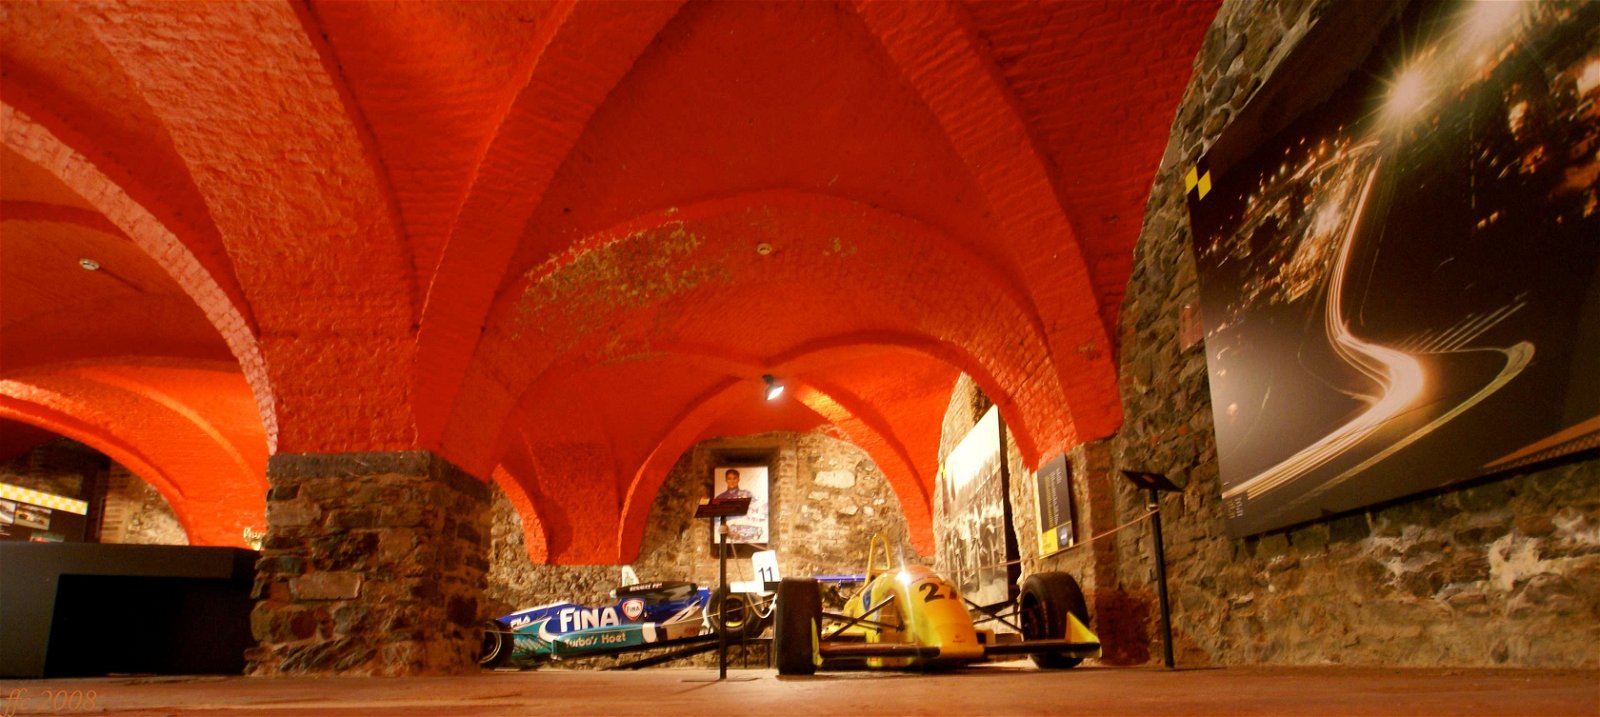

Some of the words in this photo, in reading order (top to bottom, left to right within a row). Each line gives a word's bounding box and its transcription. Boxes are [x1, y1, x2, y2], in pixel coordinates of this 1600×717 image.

[758, 566, 773, 582] 11
[626, 602, 640, 613] FINA
[559, 607, 619, 633] FINA
[564, 635, 598, 649] Turbo's
[601, 633, 626, 645] Hoet
